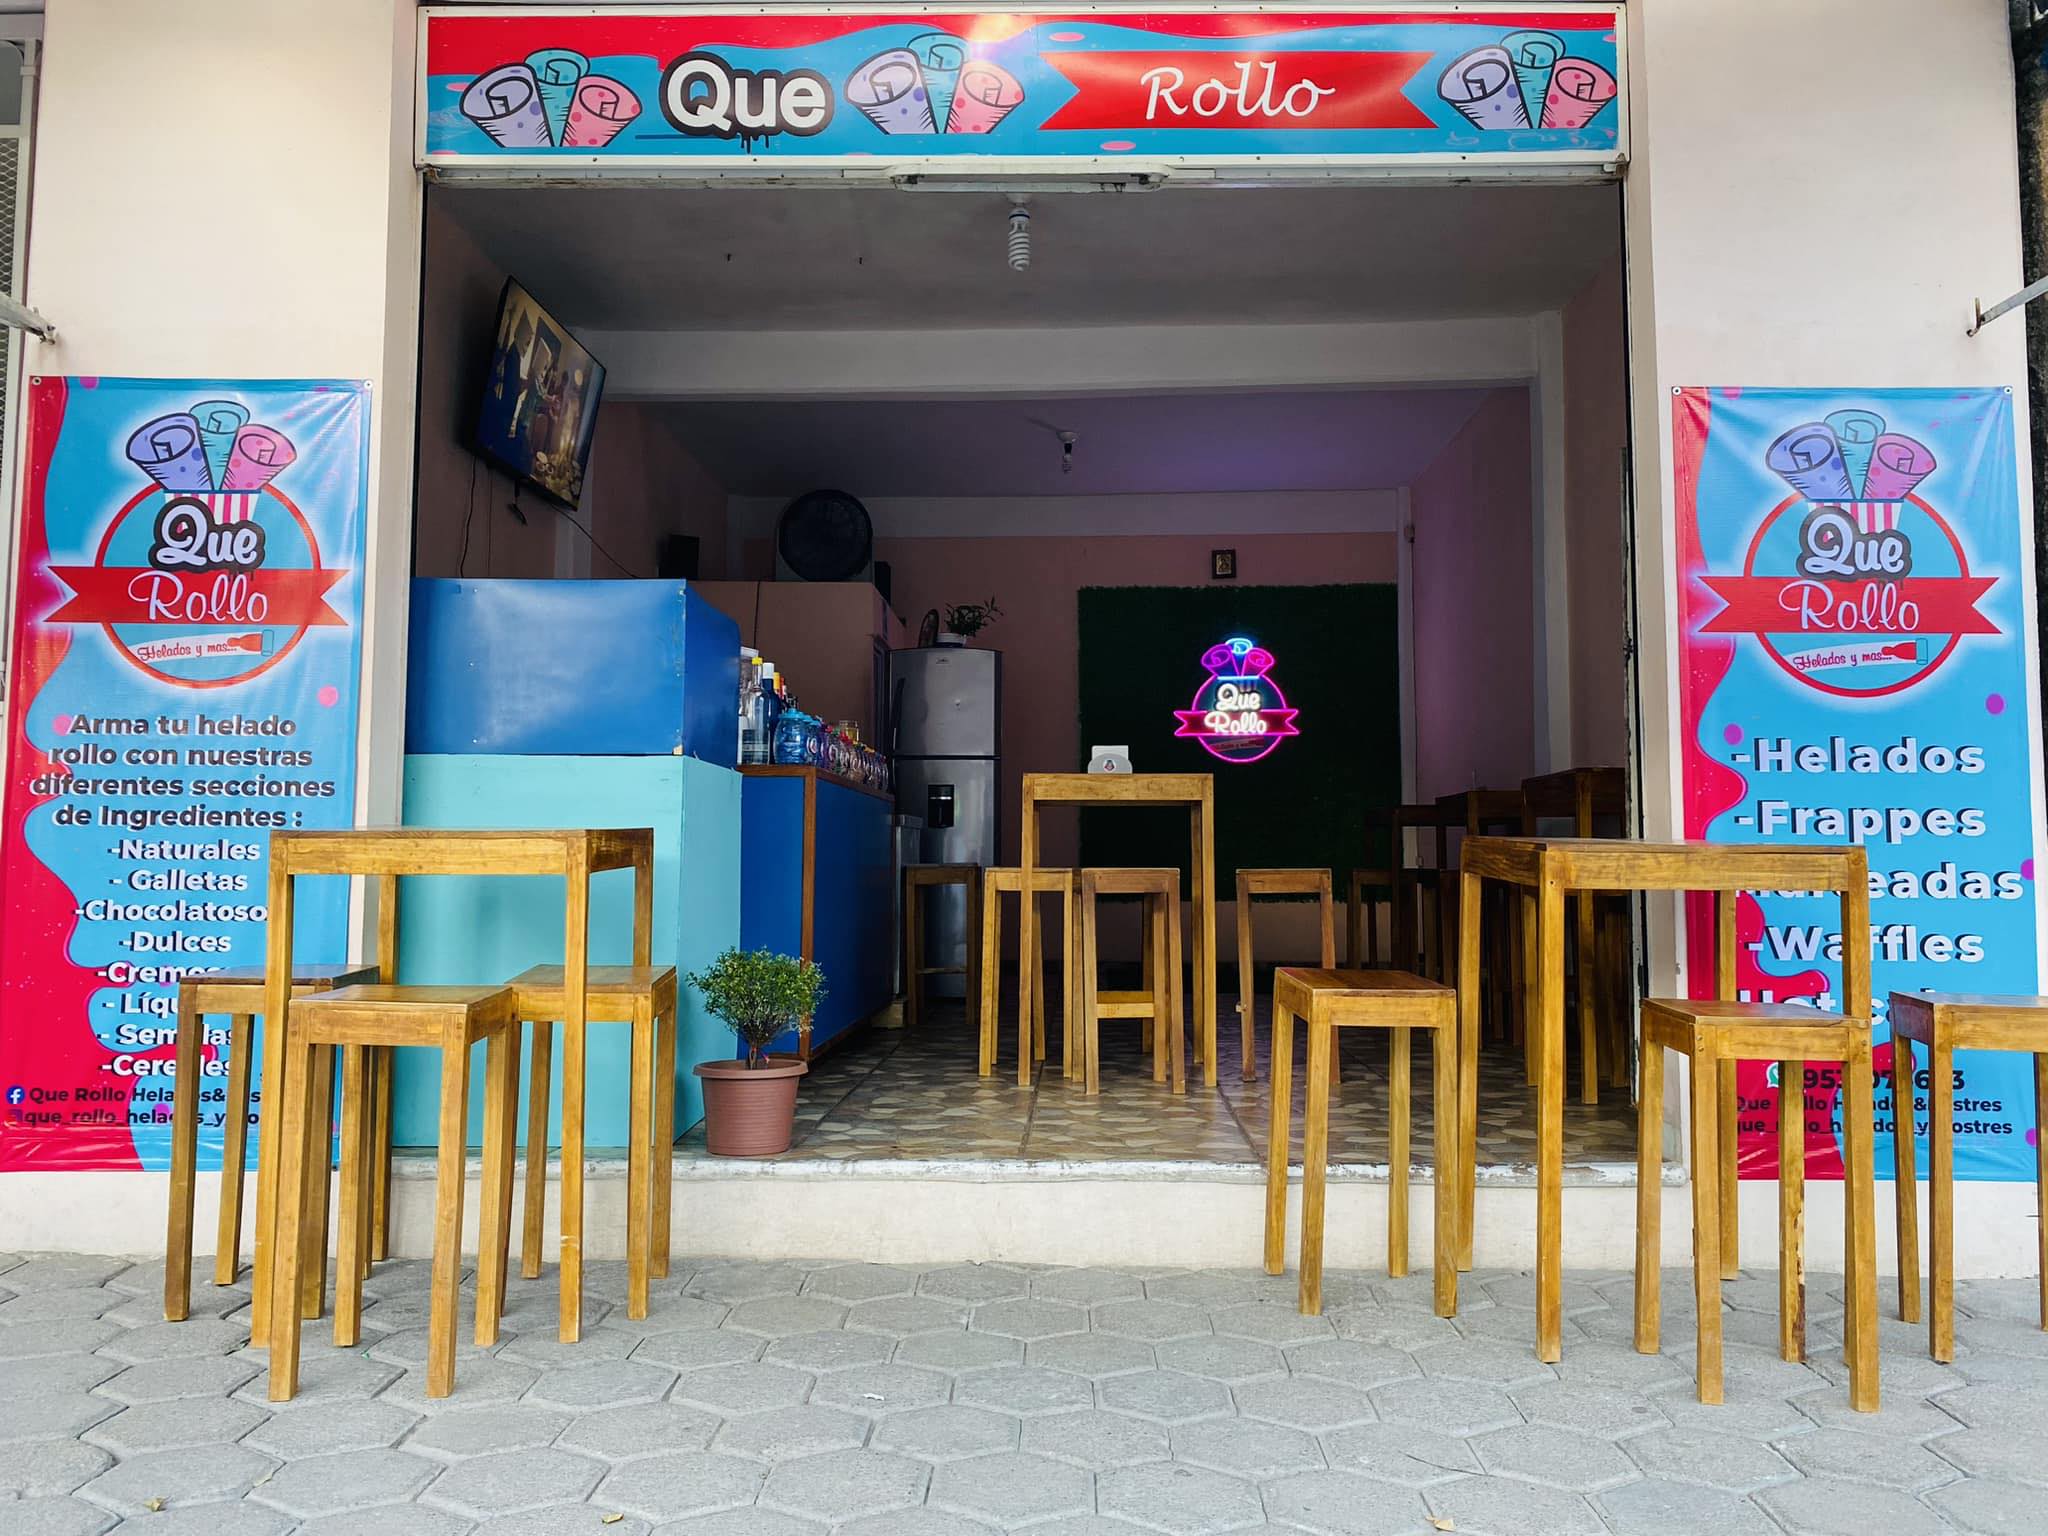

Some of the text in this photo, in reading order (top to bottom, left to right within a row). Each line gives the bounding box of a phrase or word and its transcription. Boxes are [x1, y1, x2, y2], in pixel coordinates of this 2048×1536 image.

[664, 56, 1336, 134] Que Rollo
[154, 502, 260, 567] Que
[1802, 511, 1907, 576] Que
[128, 570, 269, 623] Rollo
[1778, 580, 1920, 632] Rollo
[137, 642, 191, 661] Helados
[195, 645, 202, 657] y
[1793, 652, 1846, 670] Helados
[1850, 654, 1858, 667] y
[1215, 683, 1260, 711] Que
[69, 714, 297, 737] Arma tu helado
[1204, 711, 1267, 736] Rollo
[49, 744, 314, 767] rollo con nuestras
[1731, 736, 1986, 774] -Helados
[31, 774, 336, 798] diferentes secciones
[54, 804, 92, 825] de
[100, 805, 287, 830] Ingredientes
[1734, 799, 1987, 844] -Frappes
[107, 839, 261, 861] -Naturales
[128, 869, 248, 891] Galletas
[119, 931, 232, 953] -Dulces
[29, 1087, 70, 1104] Que
[75, 1087, 126, 1101] Rollo
